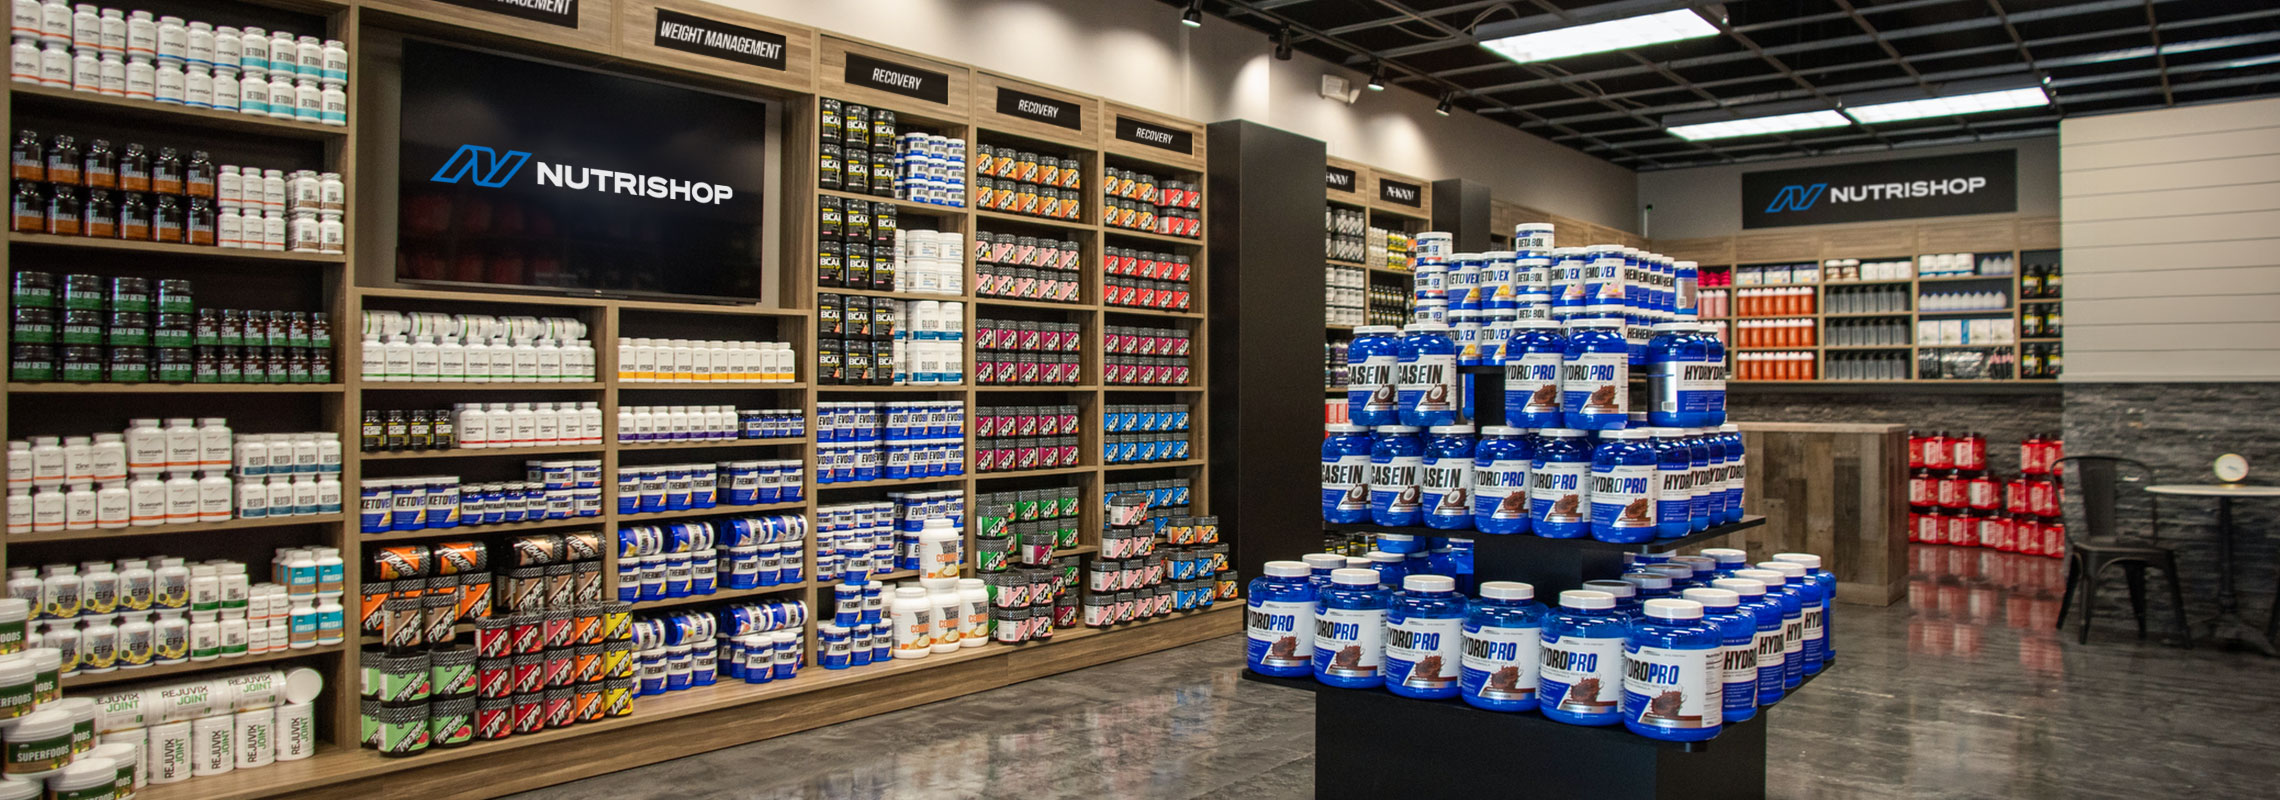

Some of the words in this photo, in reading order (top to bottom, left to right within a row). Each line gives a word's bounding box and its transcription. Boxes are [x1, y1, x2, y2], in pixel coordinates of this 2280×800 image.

[660, 20, 704, 45] WEIGHT
[704, 29, 782, 60] MANAGEMENT
[871, 67, 922, 91] RECOVERY
[1018, 99, 1059, 118] RECOVERY
[1135, 127, 1173, 145] RECOVERY
[536, 161, 733, 205] NUTRISHOP
[1830, 177, 1986, 204] NUTRISHOP
[1481, 270, 1510, 281] ETOVEX
[1552, 267, 1581, 279] EMOVEX
[1586, 266, 1616, 279] EMOVEX
[1482, 328, 1512, 340] ETOVEX
[1563, 364, 1614, 380] YDROPRO
[1423, 467, 1462, 488] ASEIN
[1475, 470, 1525, 487] YDROPRO
[95, 591, 116, 600] EFA
[131, 588, 151, 596] EFA
[167, 586, 186, 594] EFA
[57, 595, 78, 604] EFA
[1315, 618, 1359, 641] YDROPRO
[94, 645, 114, 654] EFA
[130, 642, 150, 650] EFA
[166, 637, 185, 646] EFA
[1625, 656, 1679, 685] YDROPRO
[228, 675, 272, 687] REJUVIX
[243, 681, 272, 693] JOINT
[162, 686, 208, 699] REJUVIX
[177, 693, 208, 705] JOINT
[106, 701, 139, 713] JOINT
[257, 724, 266, 750] JOINT
[292, 717, 300, 755] REJUVIX
[300, 717, 309, 742] JOINT
[175, 738, 184, 764] JOINT
[212, 730, 221, 769] REJUVIX
[221, 730, 229, 756] JOINT
[248, 724, 257, 763] REJUVIX
[17, 745, 70, 762] SUPERFOODS
[164, 738, 175, 779] REJUVIX
